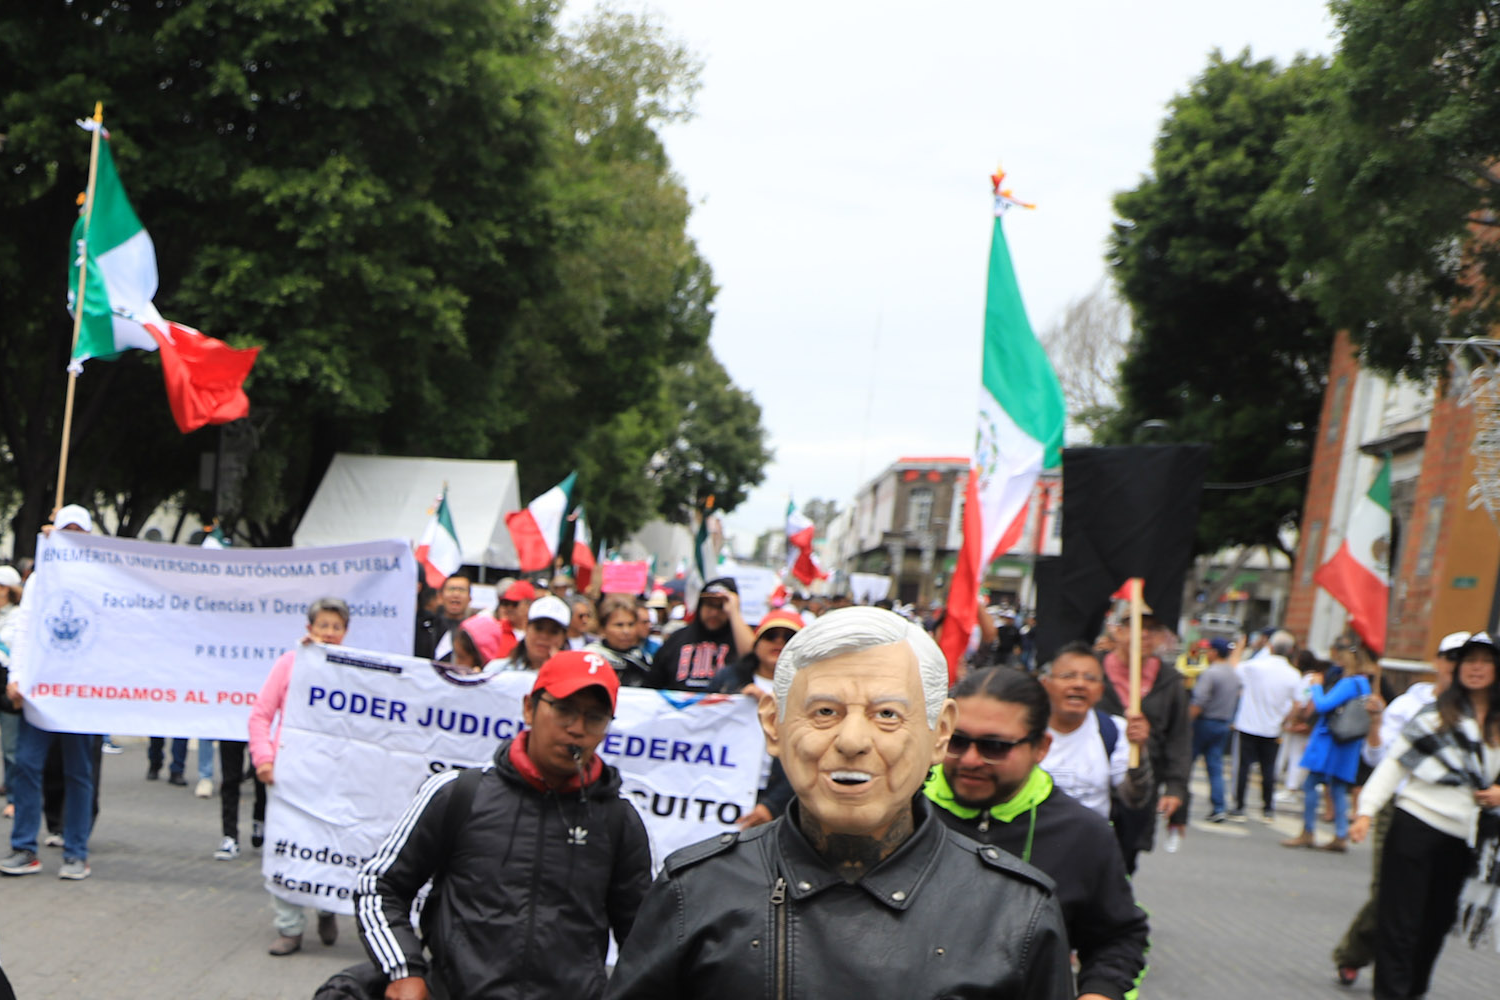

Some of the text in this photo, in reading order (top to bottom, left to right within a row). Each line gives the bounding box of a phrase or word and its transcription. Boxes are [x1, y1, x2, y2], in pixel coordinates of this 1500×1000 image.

[126, 556, 220, 576] UNIVERSIDAD
[225, 561, 315, 577] AUTÓNOMA
[320, 561, 339, 575] DE
[344, 556, 401, 573] PUEBLA
[102, 592, 164, 610] Facultad
[171, 595, 190, 610] De
[195, 595, 254, 613] Ciencias
[258, 599, 268, 613] Y
[184, 689, 209, 704] AL
[309, 686, 407, 723] PODER
[603, 733, 737, 768] EDERAL
